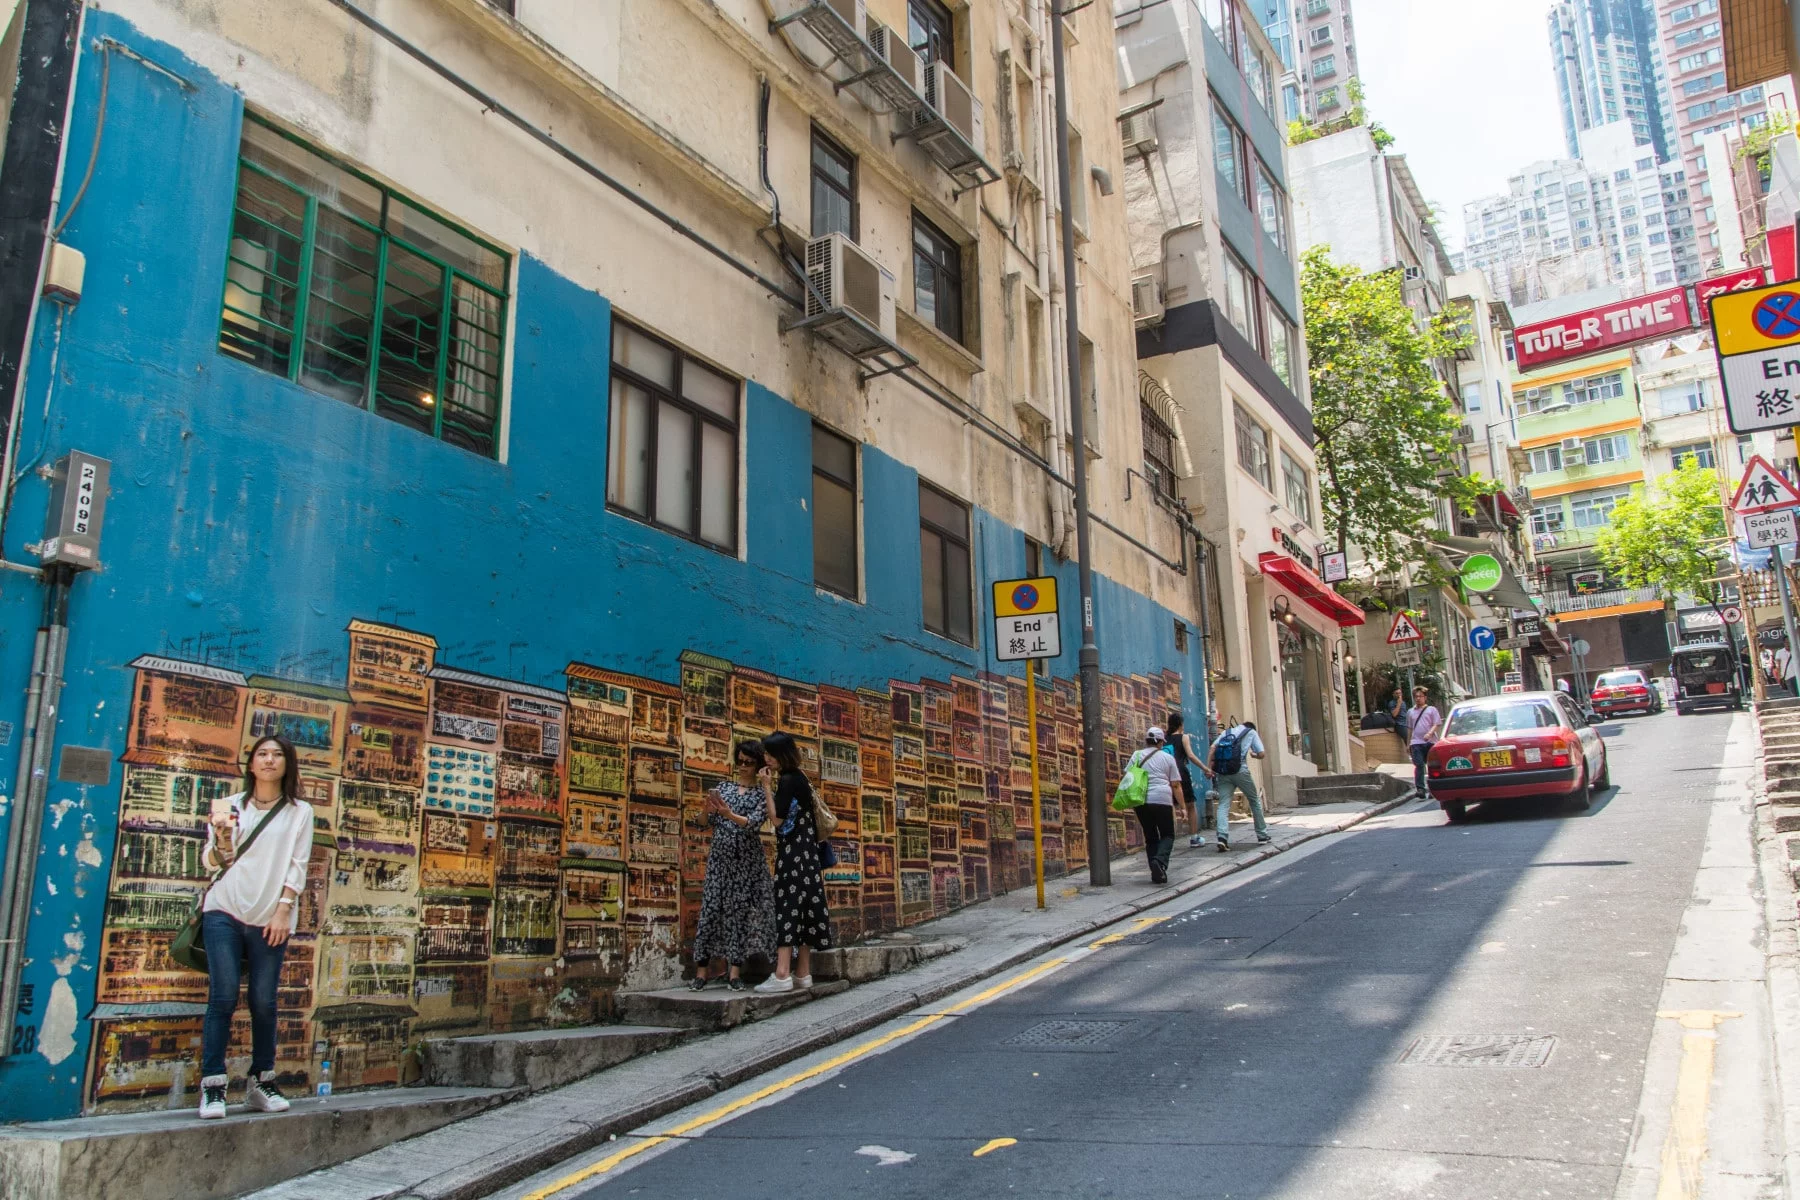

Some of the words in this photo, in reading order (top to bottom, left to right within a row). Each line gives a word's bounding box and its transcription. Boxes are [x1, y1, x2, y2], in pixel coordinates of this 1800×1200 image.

[1518, 317, 1603, 355] TUTOR
[76, 467, 94, 533] 24095
[1750, 514, 1790, 527] School
[1757, 527, 1789, 543] 學校
[1014, 619, 1042, 633] End
[1009, 636, 1048, 655] 終止
[1689, 634, 1715, 645] mint
[1484, 757, 1509, 767] 5061
